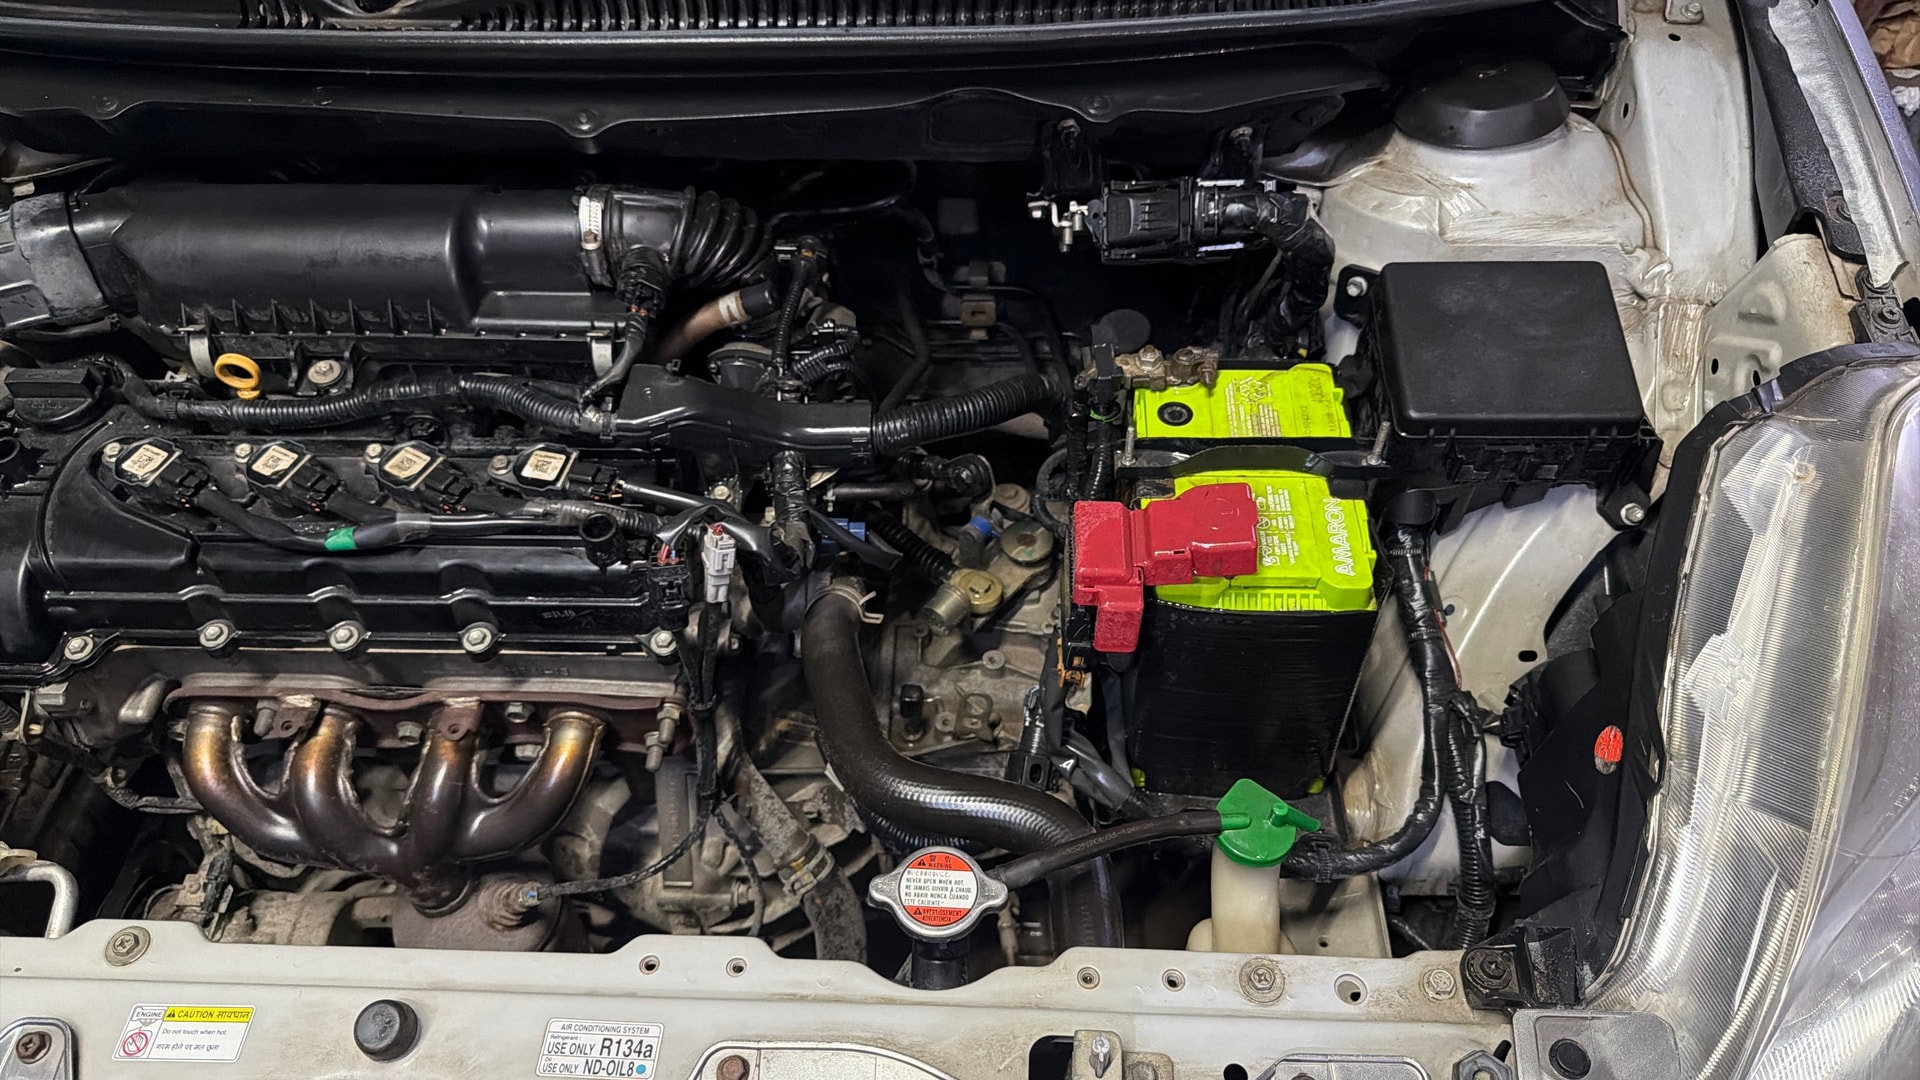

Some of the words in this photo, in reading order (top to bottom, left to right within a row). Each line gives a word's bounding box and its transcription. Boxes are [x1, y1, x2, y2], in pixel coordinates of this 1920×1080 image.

[1323, 498, 1356, 576] AMARON
[923, 908, 962, 916] AVERTISSEMENT
[177, 1010, 214, 1019] CAUTION
[216, 1010, 250, 1019] सावधान
[574, 1024, 621, 1033] CONDITIONING
[547, 1041, 567, 1054] USE
[569, 1042, 596, 1055] ONLY
[599, 1037, 653, 1058] R134a
[542, 1063, 558, 1072] USE
[559, 1063, 579, 1074] ONLY
[583, 1059, 635, 1077] ND-OIL8
